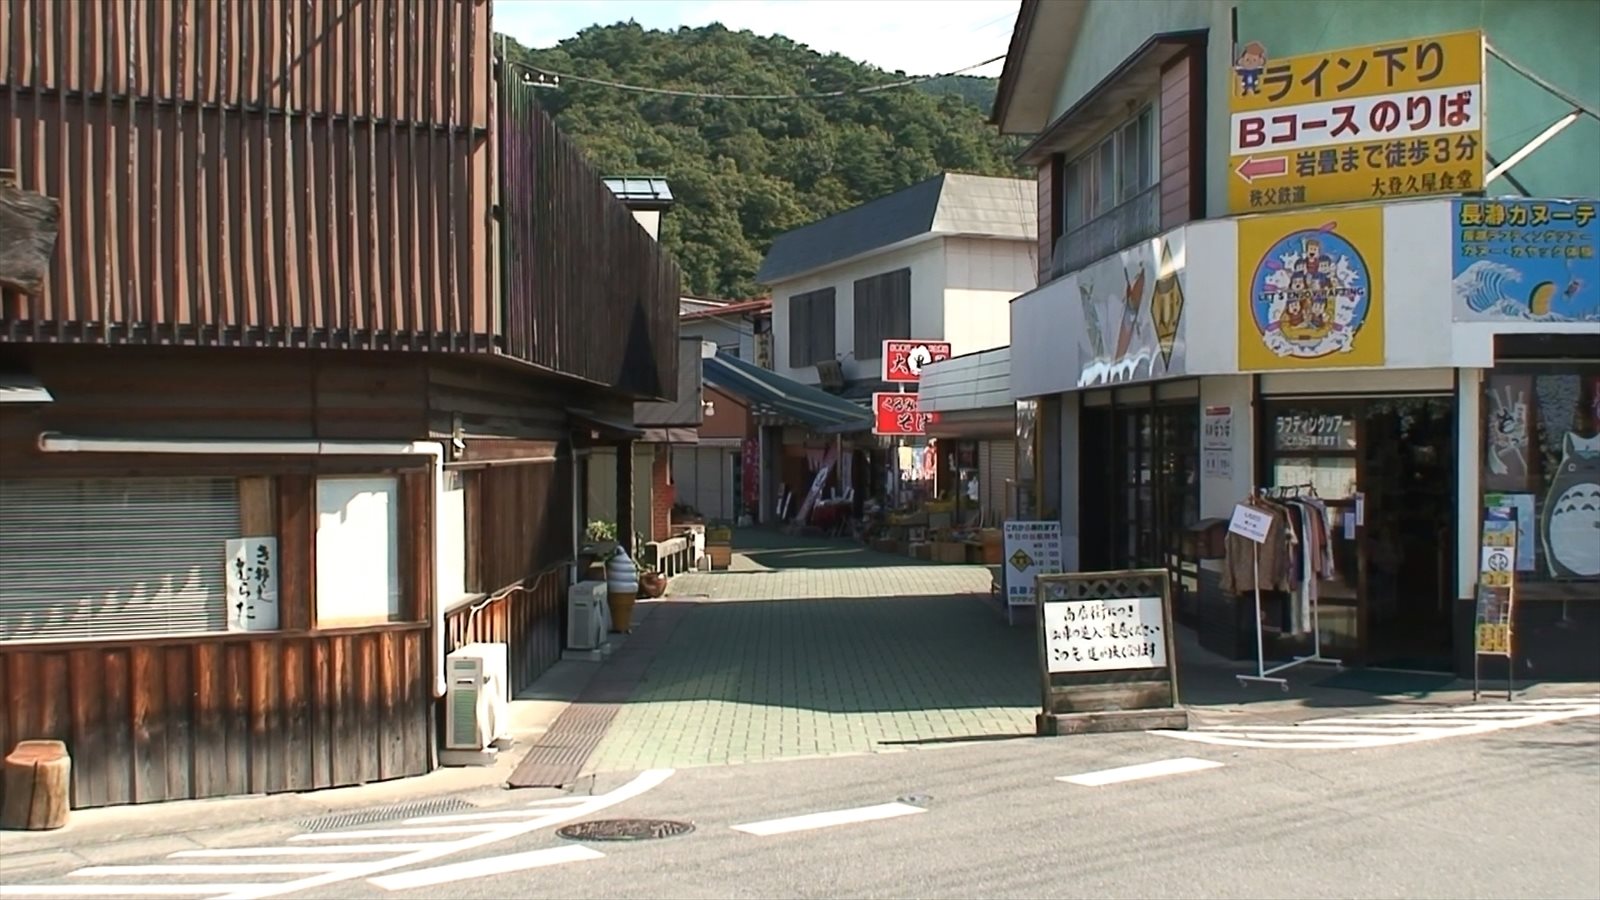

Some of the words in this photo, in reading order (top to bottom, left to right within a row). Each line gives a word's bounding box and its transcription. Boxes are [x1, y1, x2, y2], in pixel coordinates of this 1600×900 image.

[1263, 41, 1445, 102] ライン下り
[1239, 90, 1472, 149] Bコースのりば
[1295, 134, 1479, 178] 岩畳まで徒歩3分
[1250, 184, 1307, 207] 秩父鉄道
[1276, 415, 1351, 433] ラフティングツアー
